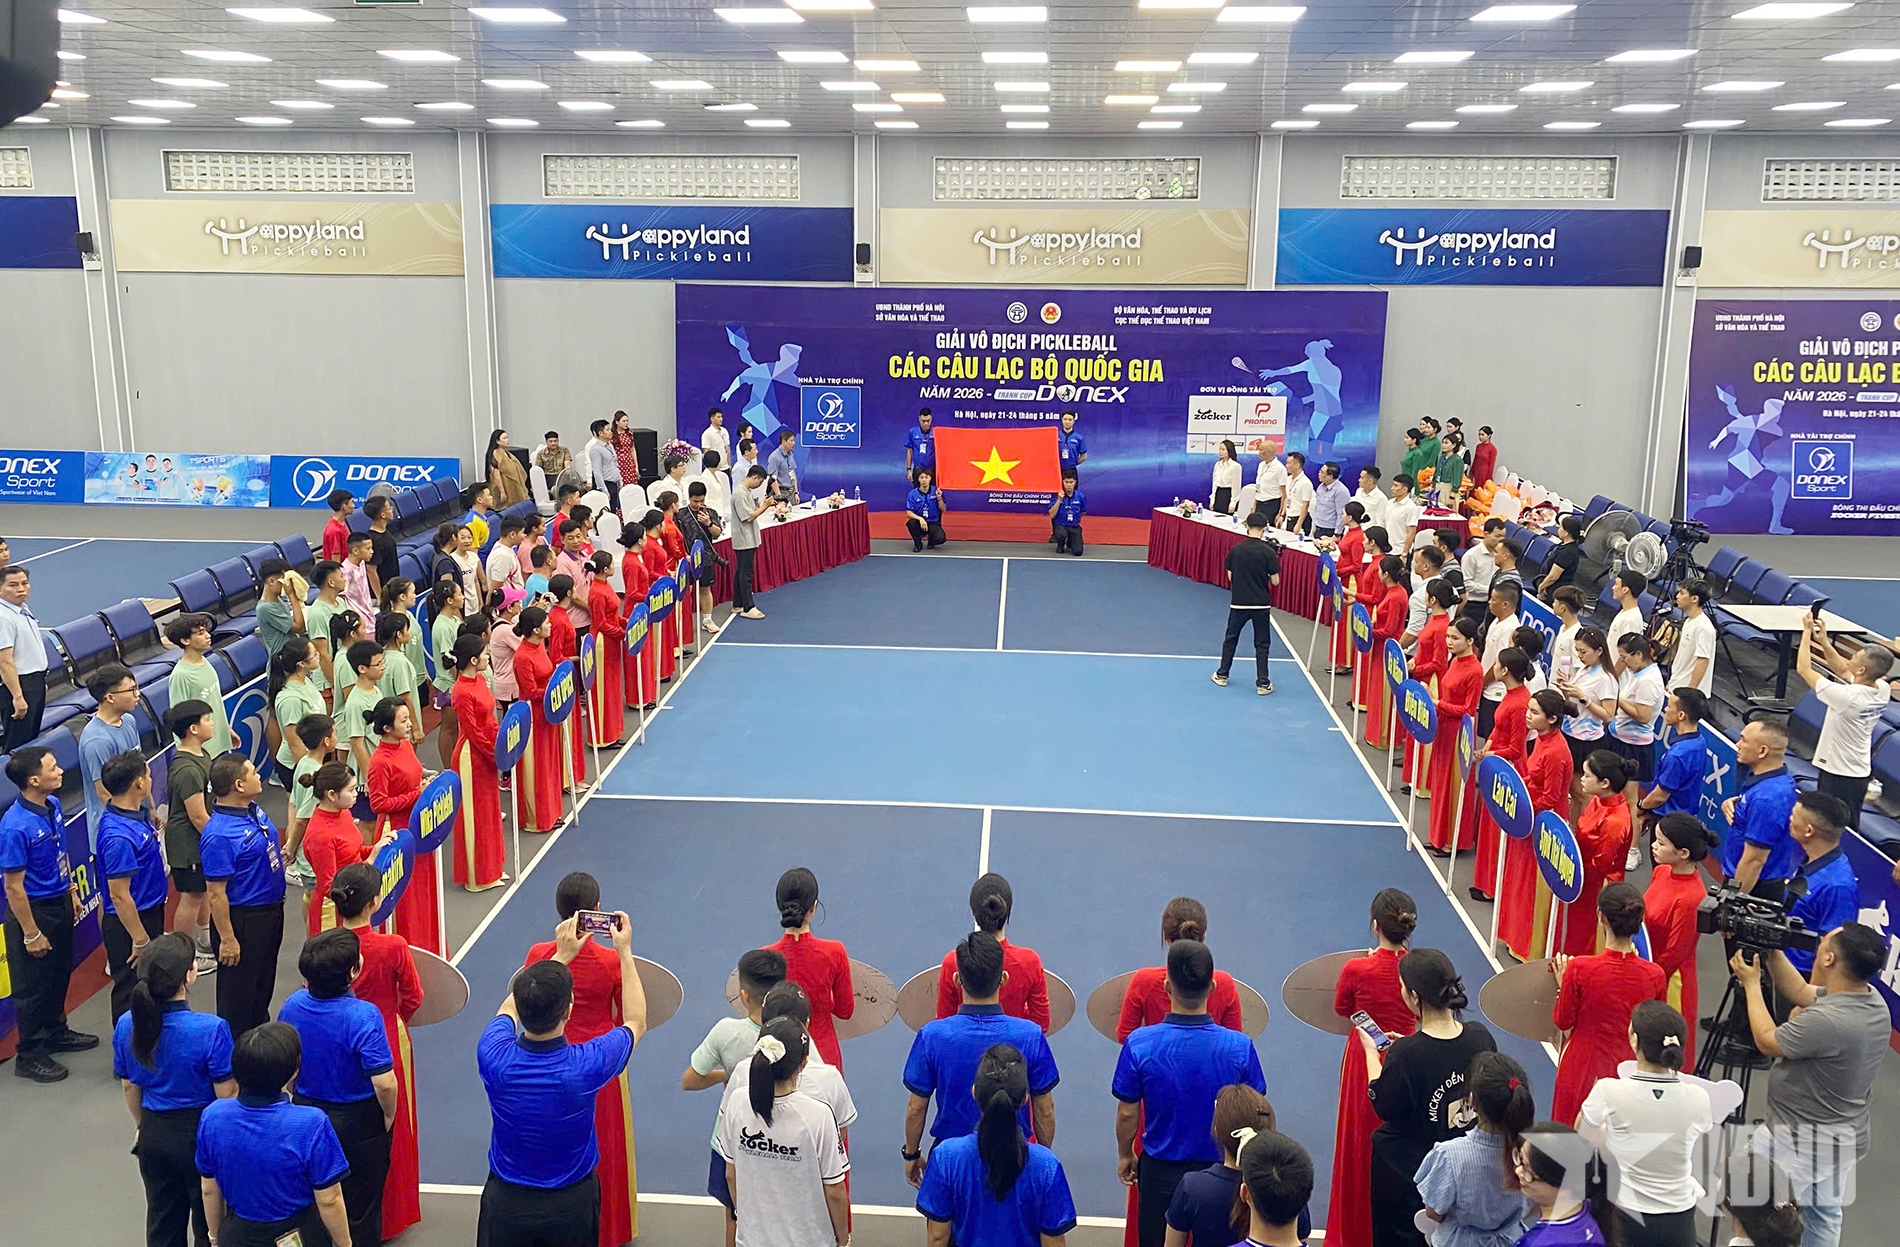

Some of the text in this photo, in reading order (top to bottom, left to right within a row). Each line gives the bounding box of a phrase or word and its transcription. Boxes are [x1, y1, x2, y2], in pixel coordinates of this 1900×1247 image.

[251, 245, 366, 257] Pickleball
[1802, 229, 1900, 268] Hap
[633, 251, 751, 262] Pickleball
[1020, 255, 1141, 266] Pickleball
[1427, 255, 1554, 267] Pickleball
[925, 303, 934, 312] HÀ
[1113, 305, 1122, 315] BỘ
[1180, 306, 1188, 314] VÀ
[1198, 307, 1212, 315] LỊCH
[909, 313, 918, 322] VÀ
[930, 314, 945, 322] THAO
[1115, 317, 1127, 326] CỤC
[1165, 317, 1180, 325] THAO
[1181, 316, 1194, 326] VIỆT
[1195, 317, 1210, 325] NAM
[935, 327, 1118, 353] GIẢI VÔ ĐỊCH PICKLEBALL
[1800, 336, 1828, 356] GIẢI
[1832, 337, 1851, 356] VÔ
[1854, 341, 1889, 359] ĐỊCH
[888, 350, 1164, 385] CÁC CÂU LẠC BỘ QUỐC GIA
[1753, 357, 1795, 383] CÁC
[1800, 358, 1842, 384] CÂU
[1847, 362, 1886, 388] LẠC
[798, 376, 864, 385] NHÀ TÀI TRỢ CHÍNH
[919, 384, 951, 399] NĂM
[953, 387, 984, 399] 2026
[998, 391, 1019, 399] TRANH
[1035, 384, 1130, 403] DONEX
[1217, 386, 1225, 394] VỊ
[1226, 385, 1248, 394] ĐỒNG
[1783, 388, 1814, 401] NĂM
[1816, 390, 1847, 401] 2026
[954, 410, 964, 418] Hà
[965, 410, 979, 420] Nội,
[980, 411, 996, 420] ngày
[998, 411, 1017, 419] 21-24
[1018, 411, 1038, 420] tháng
[1045, 412, 1060, 420] năm
[1194, 410, 1232, 421] zocker
[805, 421, 857, 433] DONEX
[816, 432, 846, 441] Sport
[0, 457, 62, 474] ONEX
[345, 464, 436, 482] DONEX
[6, 474, 56, 489] Sport
[1796, 474, 1848, 485] DONEX
[1807, 484, 1837, 493] Sport
[1832, 503, 1855, 511] BÓNG
[1869, 503, 1886, 511] ĐẤU
[1491, 773, 1517, 820] Lào Cai
[1428, 1071, 1465, 1122] MICKEY ĐẾN
[740, 1130, 799, 1156] zocker
